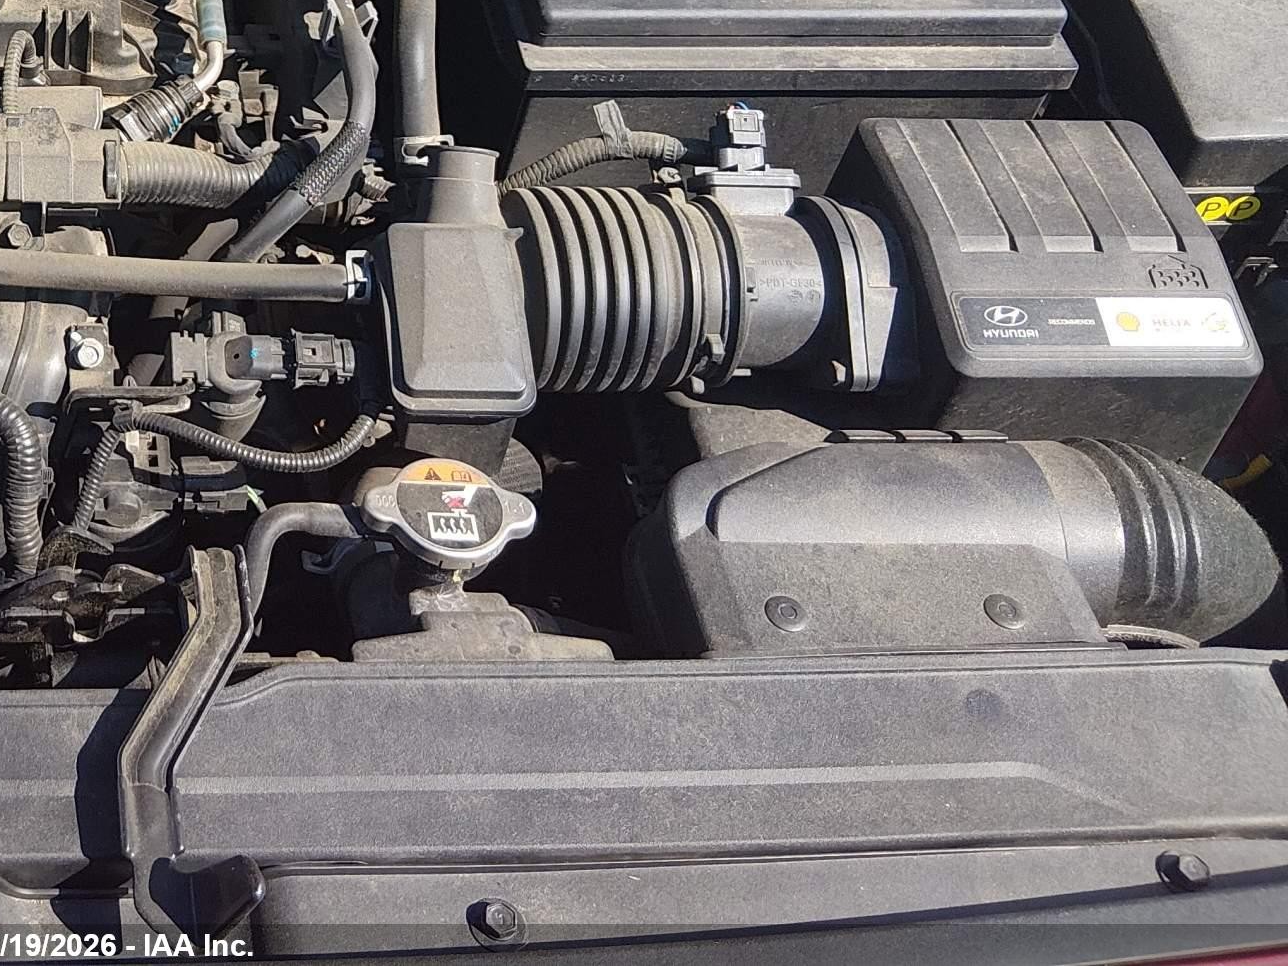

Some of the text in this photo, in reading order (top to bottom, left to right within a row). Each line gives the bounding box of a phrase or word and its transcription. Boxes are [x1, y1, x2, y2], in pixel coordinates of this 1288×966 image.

[1201, 201, 1254, 217] P P
[983, 329, 1040, 339] HYUNDAI
